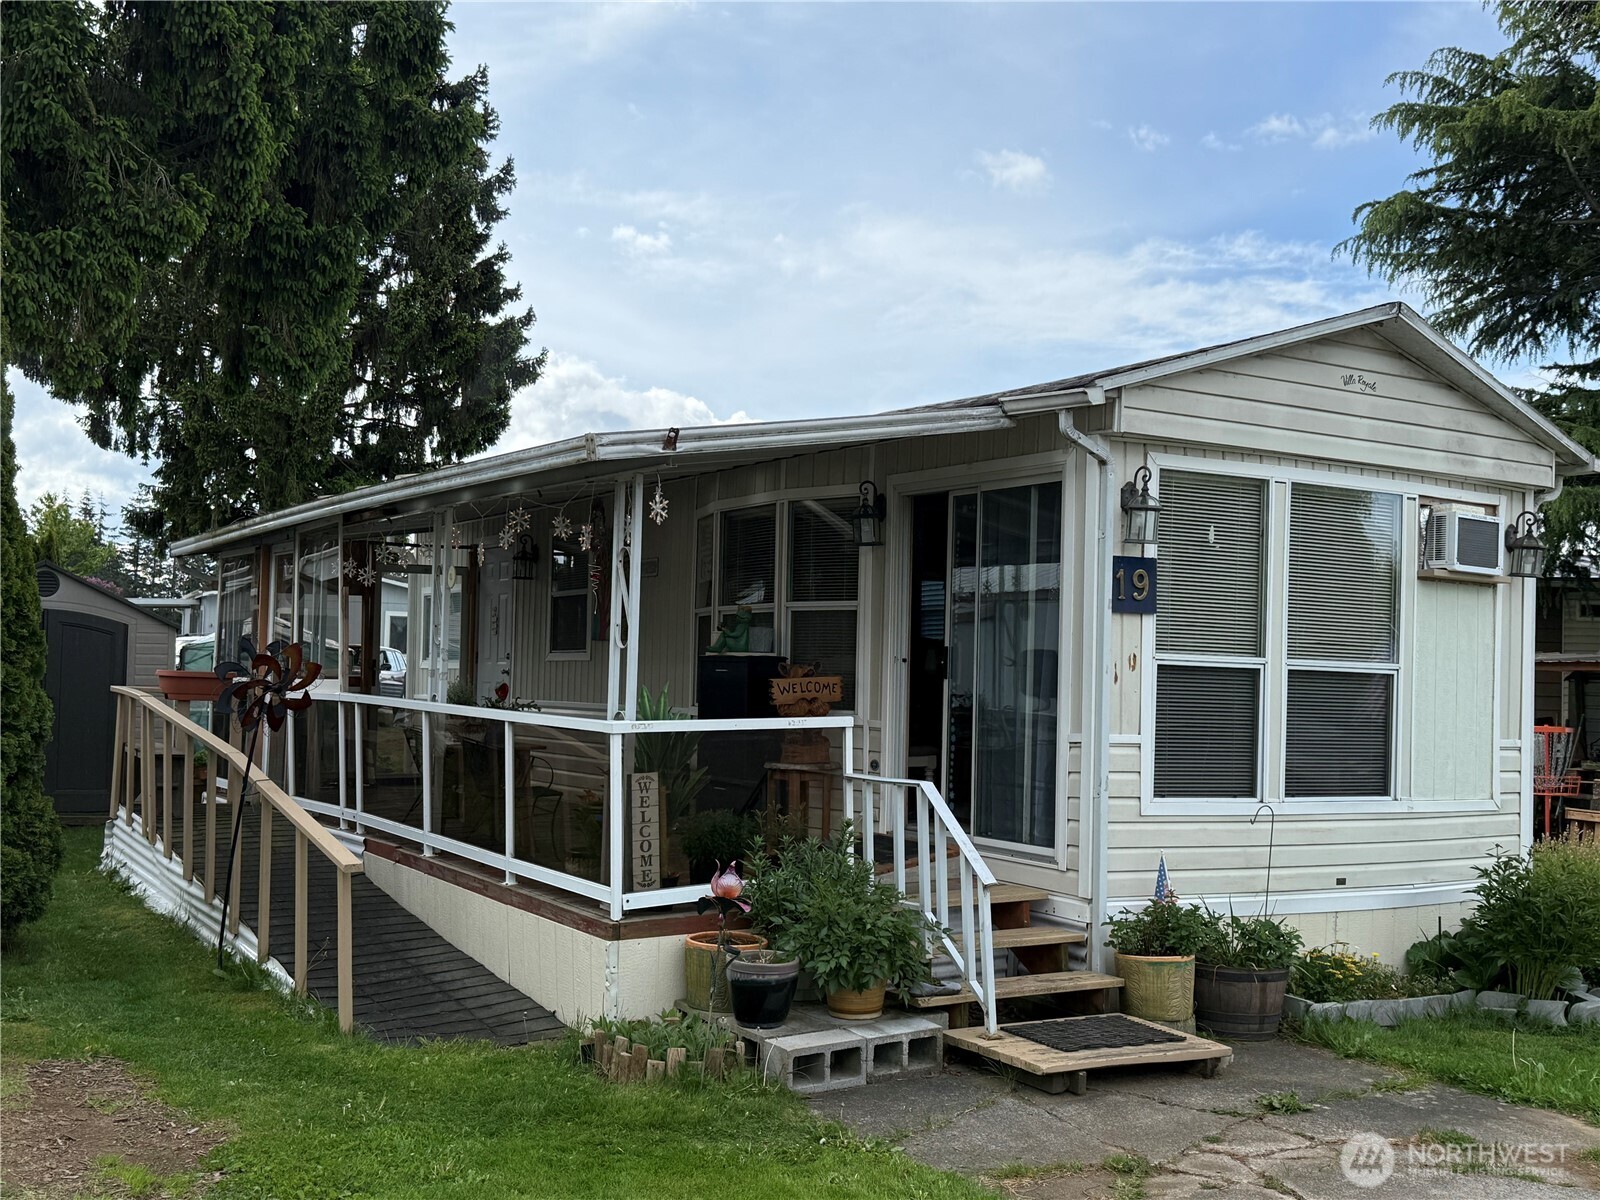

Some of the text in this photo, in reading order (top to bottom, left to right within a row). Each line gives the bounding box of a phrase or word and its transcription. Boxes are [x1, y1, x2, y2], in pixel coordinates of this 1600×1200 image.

[1340, 374, 1356, 387] Villa
[1115, 568, 1149, 601] 19
[776, 680, 838, 696] WELCOME
[637, 781, 653, 883] WELCOME
